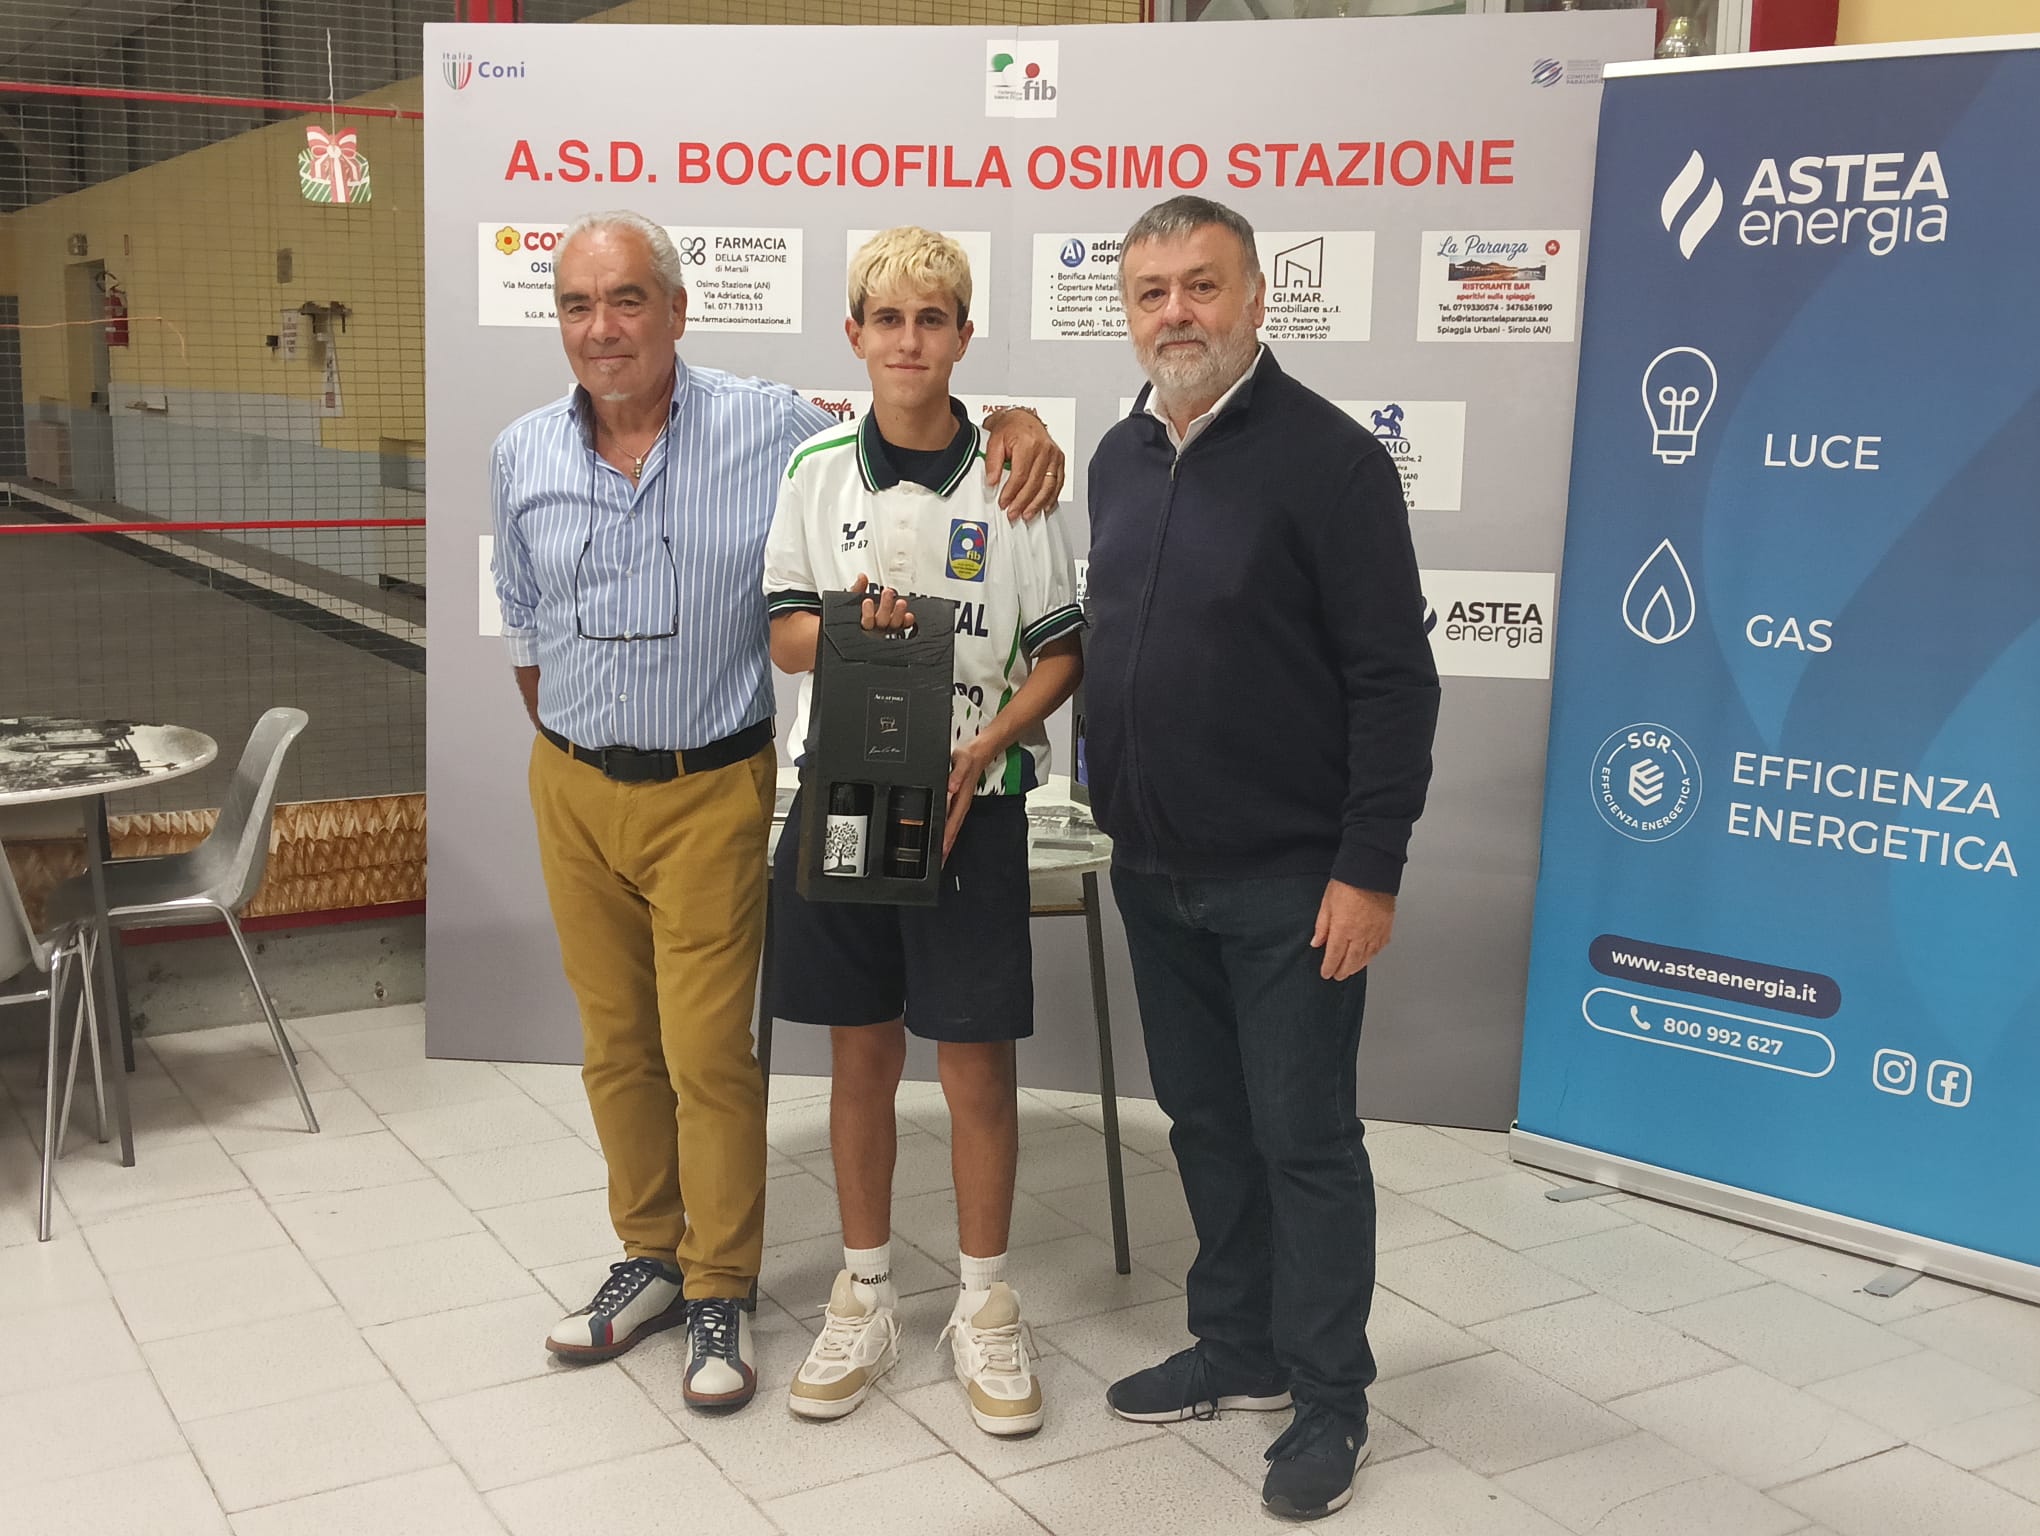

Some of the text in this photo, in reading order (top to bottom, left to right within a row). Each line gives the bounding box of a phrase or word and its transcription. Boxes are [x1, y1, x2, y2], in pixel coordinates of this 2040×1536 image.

[442, 52, 472, 60] Italia
[478, 61, 525, 78] Coni
[1022, 79, 1057, 101] fib
[504, 139, 1515, 190] A.S.D. BOCCIOFILA OSIMO STAZIONE
[1742, 151, 1949, 206] ASTEA
[1739, 204, 1948, 256] energia
[523, 232, 564, 251] CO
[715, 236, 787, 250] FARMACIA
[1091, 240, 1122, 251] adria
[1437, 234, 1530, 261] La Paranza
[715, 253, 787, 263] DELLA STAZIONE
[530, 261, 554, 273] OSI
[715, 265, 722, 273] di
[1057, 272, 1086, 280] Bonifica
[502, 281, 555, 290] Via Montefa
[696, 280, 771, 290] Osimo Stazione (AN)
[1057, 283, 1093, 292] Coperture
[703, 291, 763, 300] Via Adriatica, 60
[1057, 294, 1093, 303] Coperture
[1272, 292, 1325, 303] GI.MAR.
[1456, 293, 1486, 301] aperitivi
[704, 302, 763, 311] Tel. 071.781313
[1056, 305, 1093, 313] Lattonerie
[1264, 305, 1342, 313] mmobiliare s.r.l.
[1051, 319, 1076, 327] Osimo
[1077, 319, 1095, 328] (AN)
[1101, 319, 1115, 327] Tel.
[1116, 319, 1127, 327] 07
[1314, 325, 1331, 333] (AN)
[1437, 326, 1472, 334] Spiaggia
[1532, 325, 1552, 334] (AN)
[1061, 329, 1128, 339] www.adriaticacope
[1385, 441, 1411, 454] MO
[1764, 433, 1882, 470] LUCE
[1447, 601, 1543, 625] ASTEA
[1445, 624, 1543, 648] energia
[1745, 614, 1833, 653] GAS
[1627, 731, 1671, 754] SGR
[1732, 751, 2001, 819] EFFICIENZA
[1601, 766, 1691, 831] EFFICIENZA ENERGETICA
[1727, 802, 2018, 877] ENERGETICA
[1611, 948, 1818, 1004] www.asteaenergia.it
[1663, 1016, 1784, 1057] 800 992 627
[860, 1271, 888, 1285] adid
